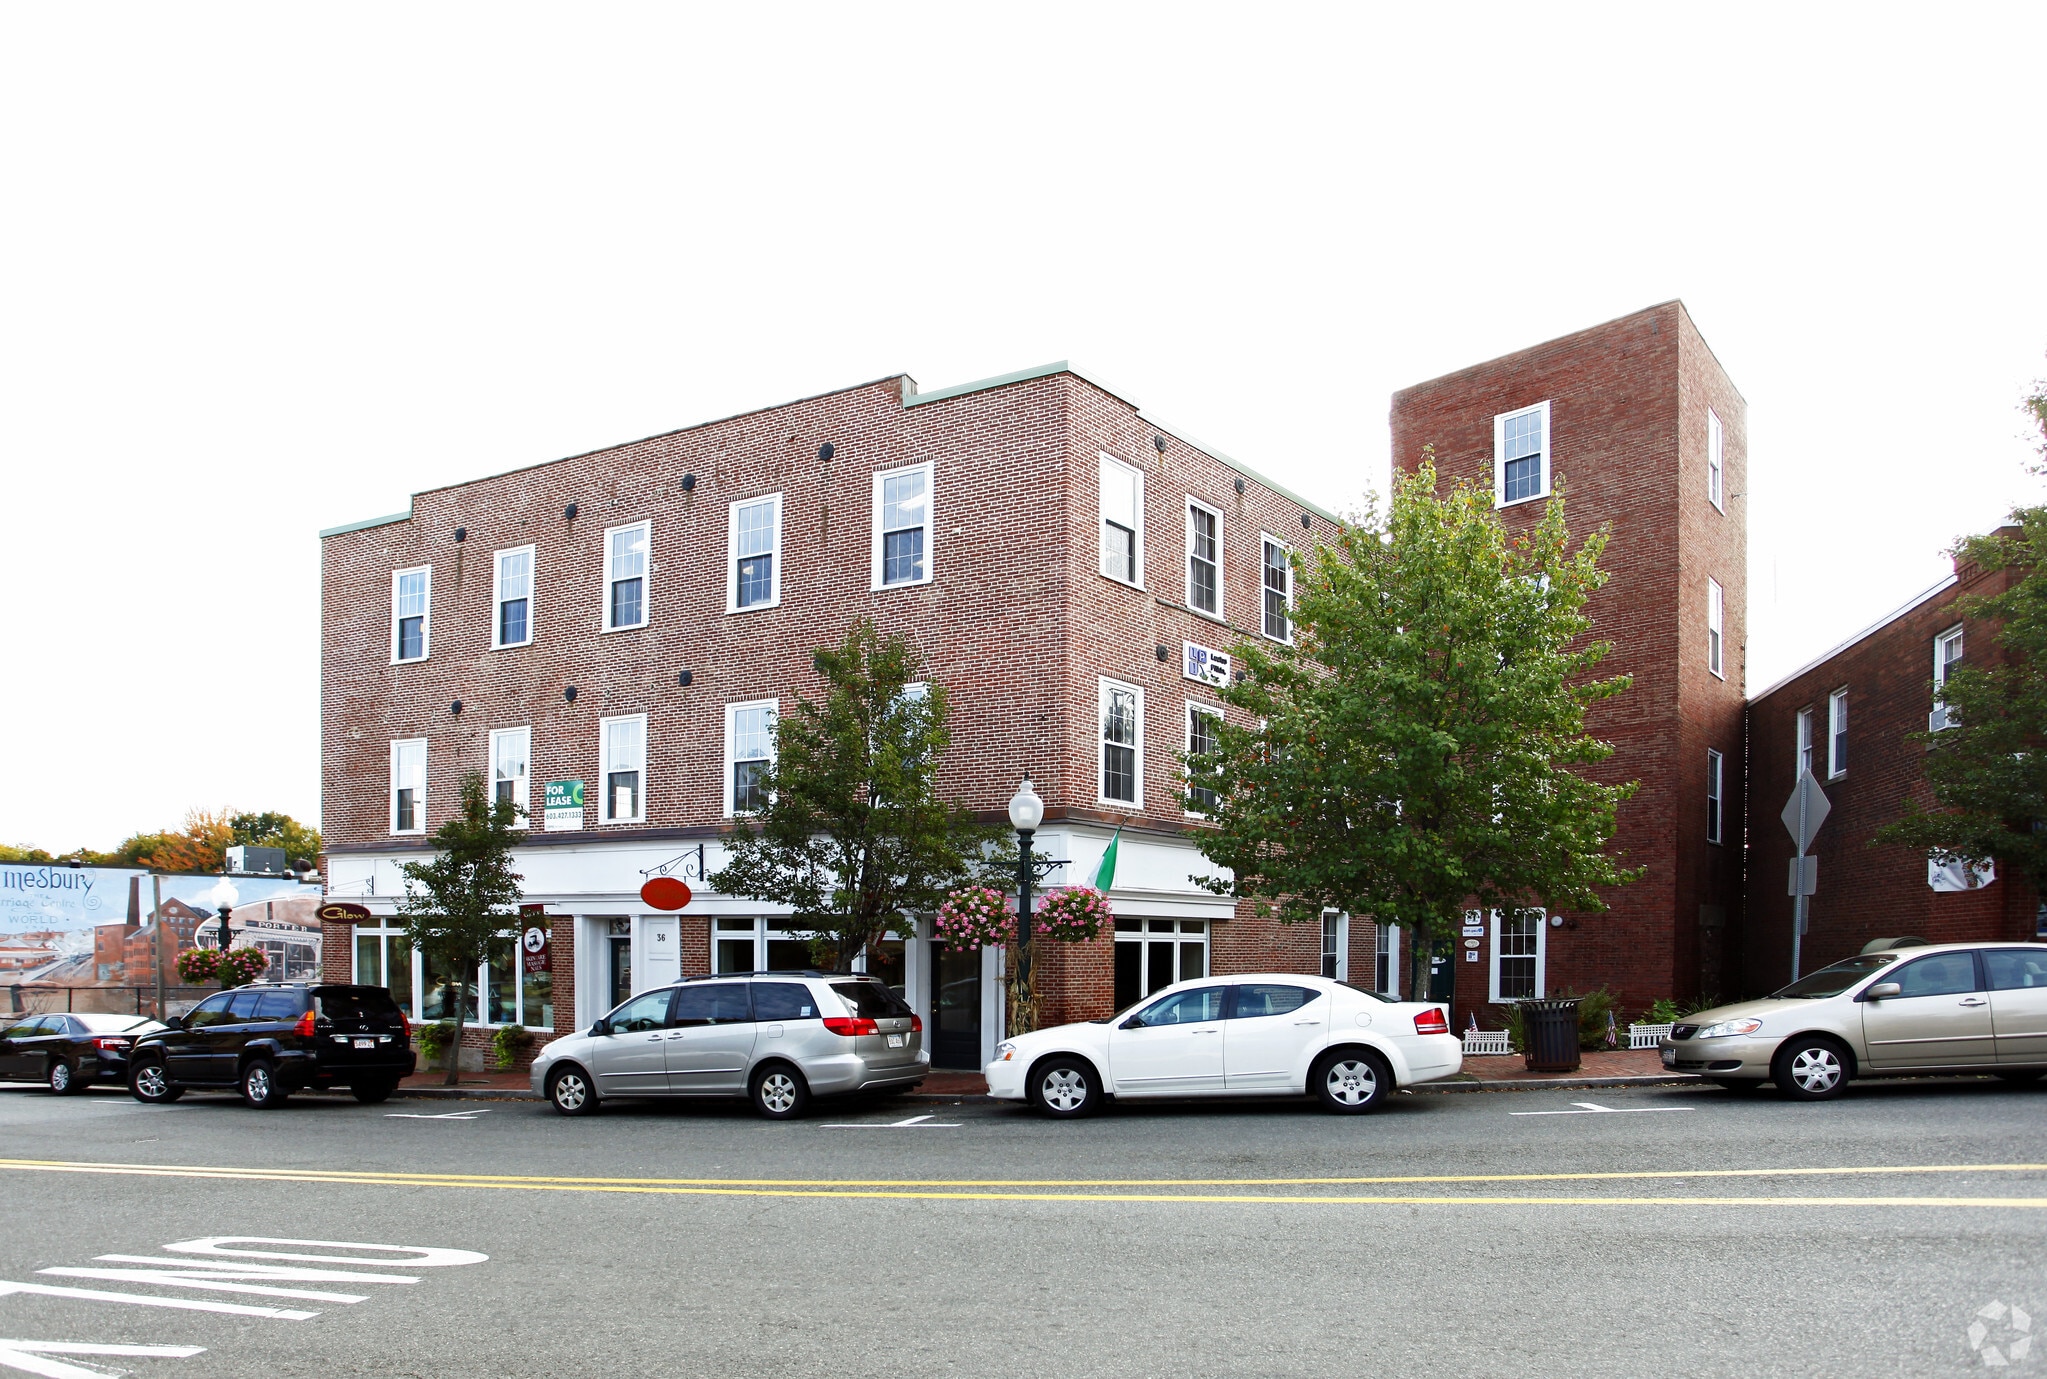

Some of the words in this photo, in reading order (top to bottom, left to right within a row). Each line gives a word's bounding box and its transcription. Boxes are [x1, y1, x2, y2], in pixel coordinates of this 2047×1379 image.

[546, 785, 564, 796] FOR
[546, 796, 572, 807] LEASE
[322, 907, 365, 919] Glow
[9, 915, 58, 924] WORLD
[258, 921, 308, 933] PORTER
[656, 933, 666, 942] 36
